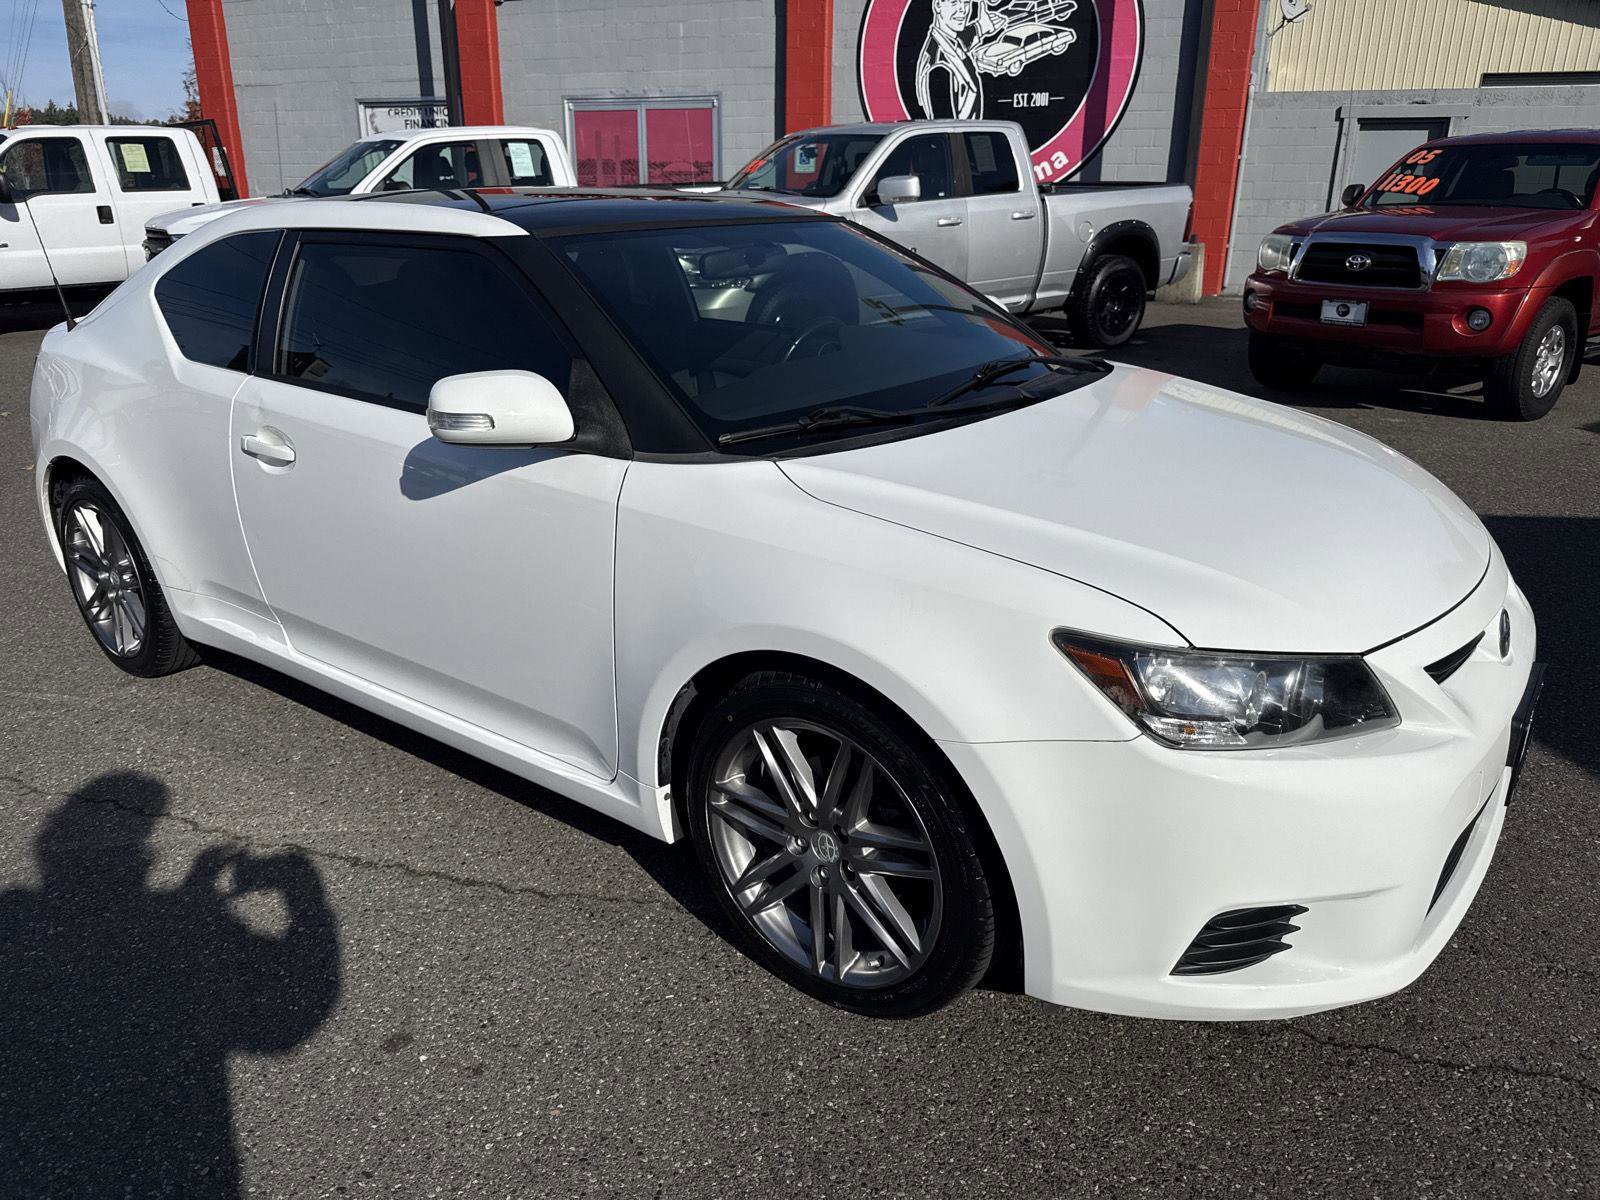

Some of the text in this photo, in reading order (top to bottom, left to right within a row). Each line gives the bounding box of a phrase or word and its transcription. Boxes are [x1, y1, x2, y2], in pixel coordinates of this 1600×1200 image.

[1013, 92, 1049, 108] EST. 2001
[387, 106, 449, 117] CREDIT UNIO
[404, 118, 450, 130] FINANCIN
[1405, 149, 1443, 165] 05
[1376, 173, 1440, 196] 11300
